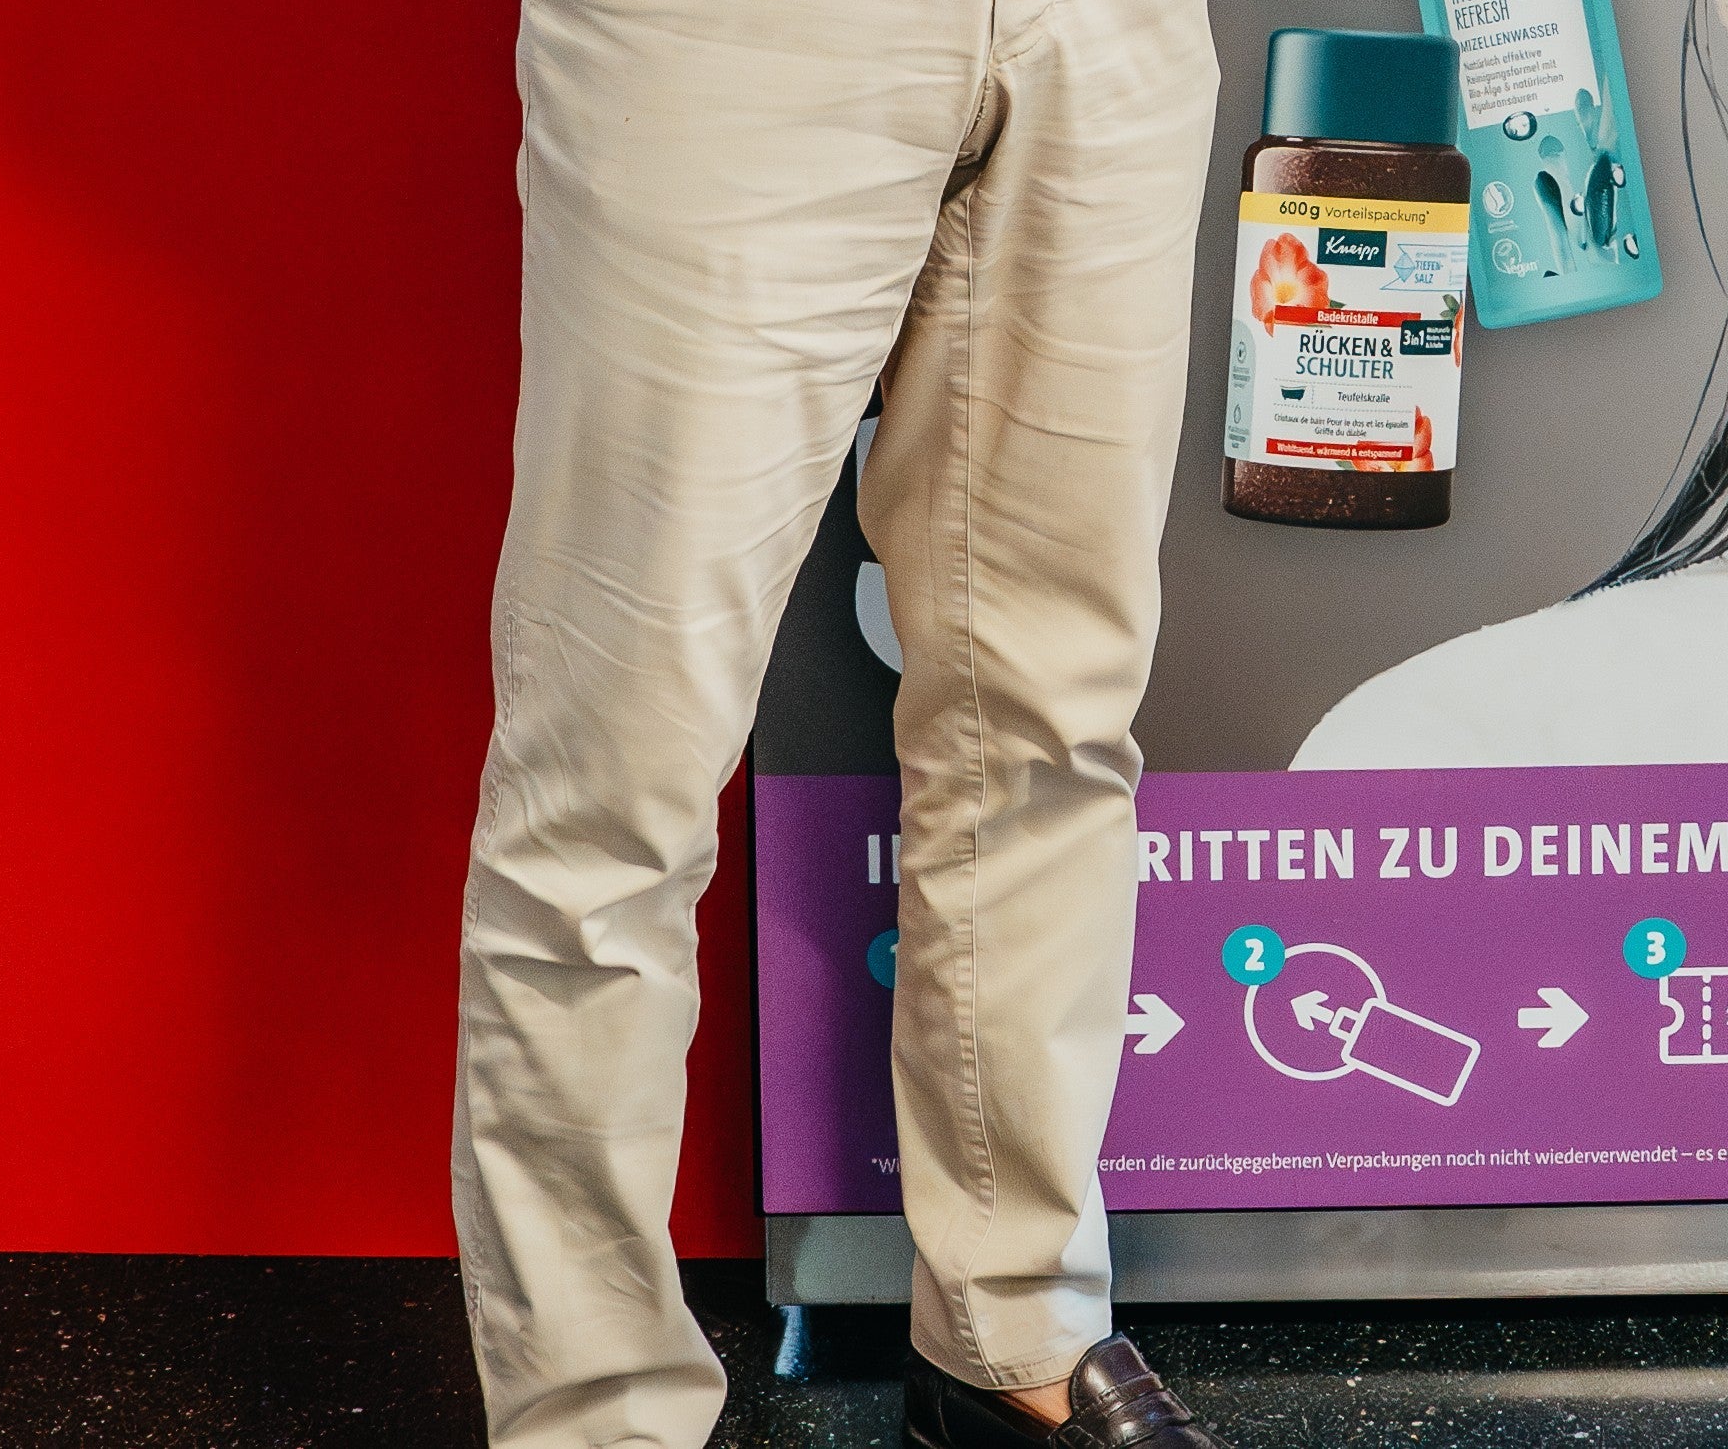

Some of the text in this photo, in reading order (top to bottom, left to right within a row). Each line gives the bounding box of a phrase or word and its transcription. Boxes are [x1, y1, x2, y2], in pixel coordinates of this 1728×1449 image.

[1460, 21, 1560, 54] MIZELLENWASSER
[1325, 235, 1380, 263] Kneipp
[1414, 272, 1434, 284] SALZ
[1317, 311, 1380, 326] Badekristalle
[1298, 329, 1394, 358] RÜCKEN &
[1295, 354, 1395, 380] SCHULTER
[1337, 391, 1392, 404] Teufelskralle
[867, 833, 902, 884] I
[1136, 827, 1357, 883] RITTEN
[1378, 826, 1460, 881] ZU
[1243, 938, 1266, 972] 2
[1645, 931, 1666, 965] 3
[1096, 1154, 1146, 1172] erden
[1150, 1153, 1176, 1171] die
[1178, 1151, 1322, 1177] zurückgegebenen
[1325, 1150, 1441, 1175] Verpackungen
[1445, 1148, 1486, 1168] noch
[1489, 1147, 1531, 1167] nicht
[1534, 1144, 1678, 1166] wiederverwendet
[1695, 1147, 1714, 1162] es
